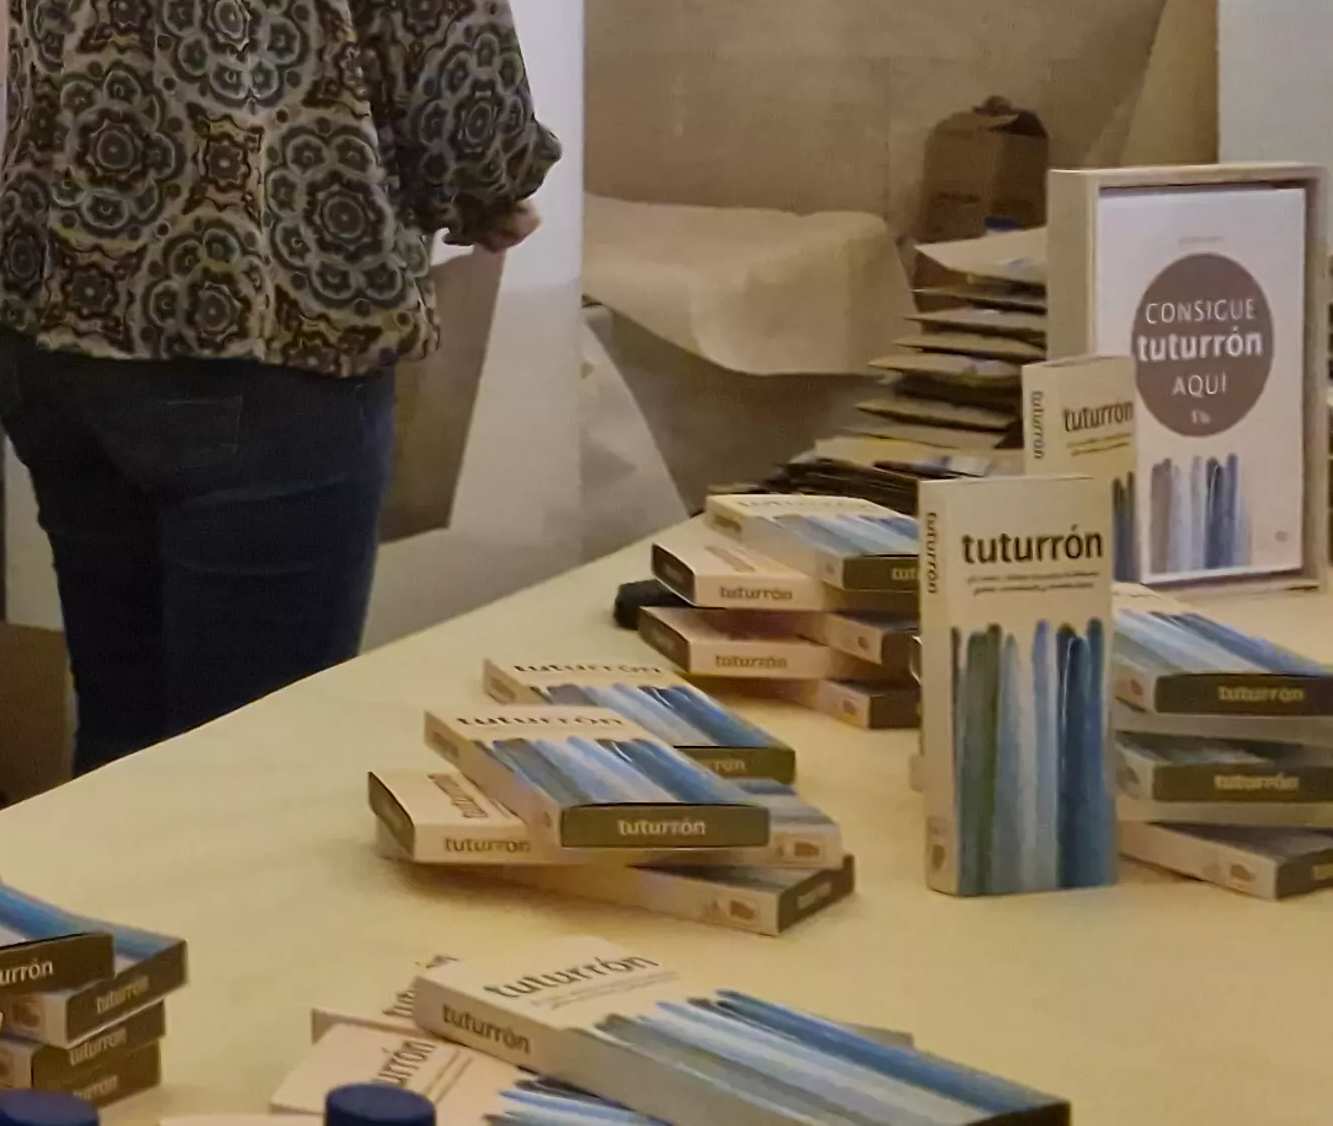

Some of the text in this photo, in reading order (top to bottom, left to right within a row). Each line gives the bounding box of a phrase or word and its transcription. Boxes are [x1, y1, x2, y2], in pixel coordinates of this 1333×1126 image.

[1145, 298, 1256, 324] CONSIGUE
[1136, 326, 1264, 362] tuturrón
[961, 523, 1104, 564] tuturrón
[617, 817, 707, 837] tuturrón
[482, 954, 661, 1000] tuturrón
[441, 1001, 532, 1055] tuturrón
